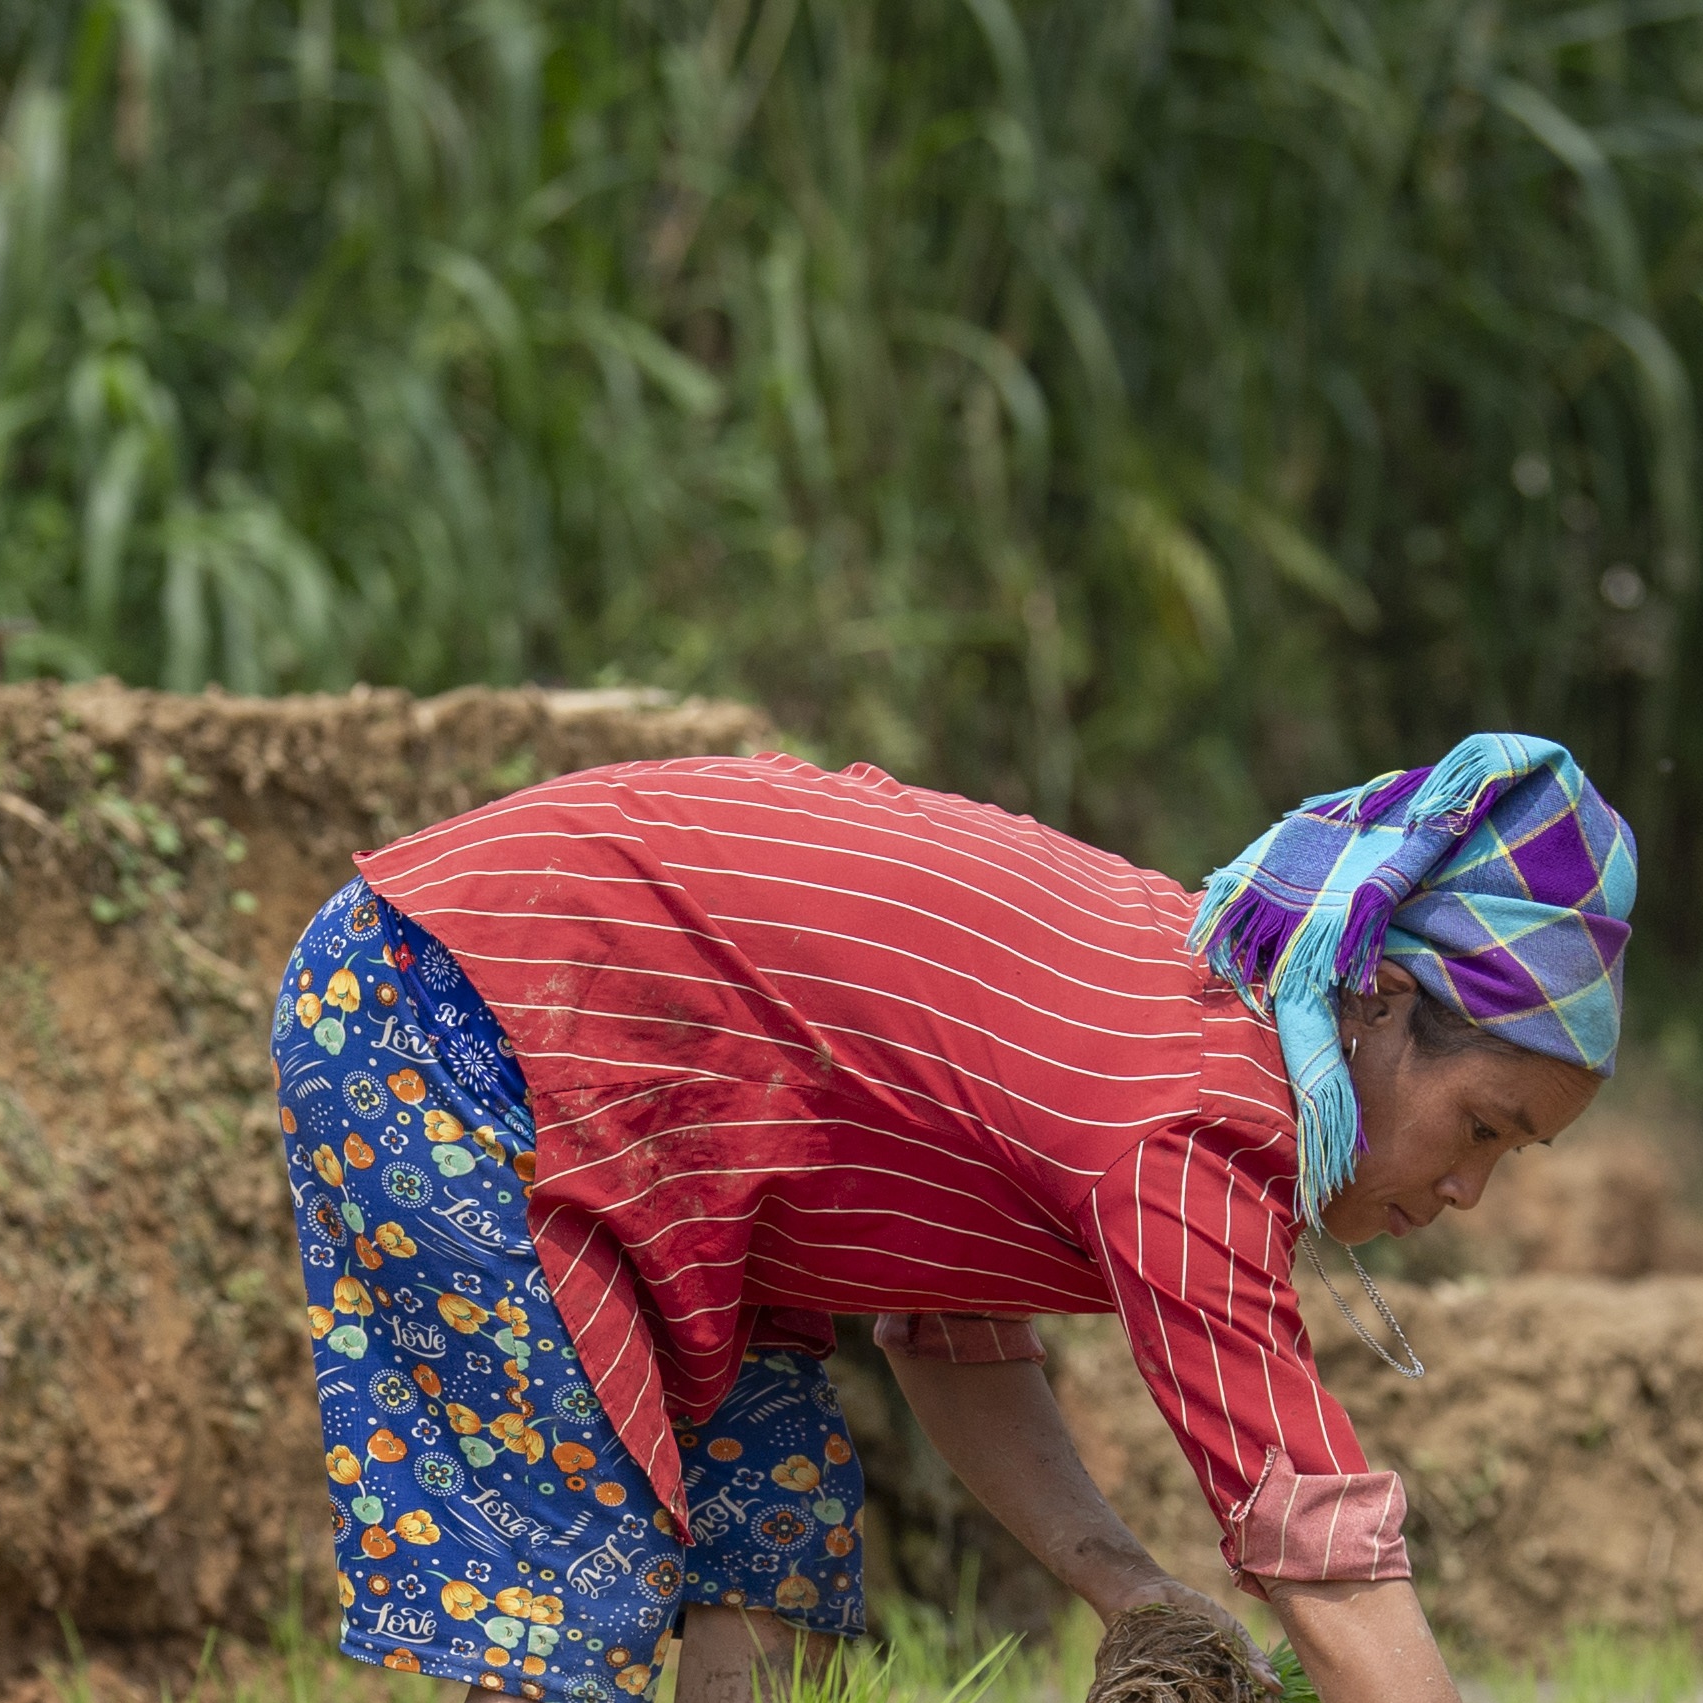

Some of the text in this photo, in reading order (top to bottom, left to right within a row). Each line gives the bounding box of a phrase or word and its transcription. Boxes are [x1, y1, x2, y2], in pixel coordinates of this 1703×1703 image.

[379, 1312, 447, 1358] Love
[688, 1486, 762, 1546] Love
[566, 1533, 646, 1600] Love
[361, 1602, 437, 1643] Love
